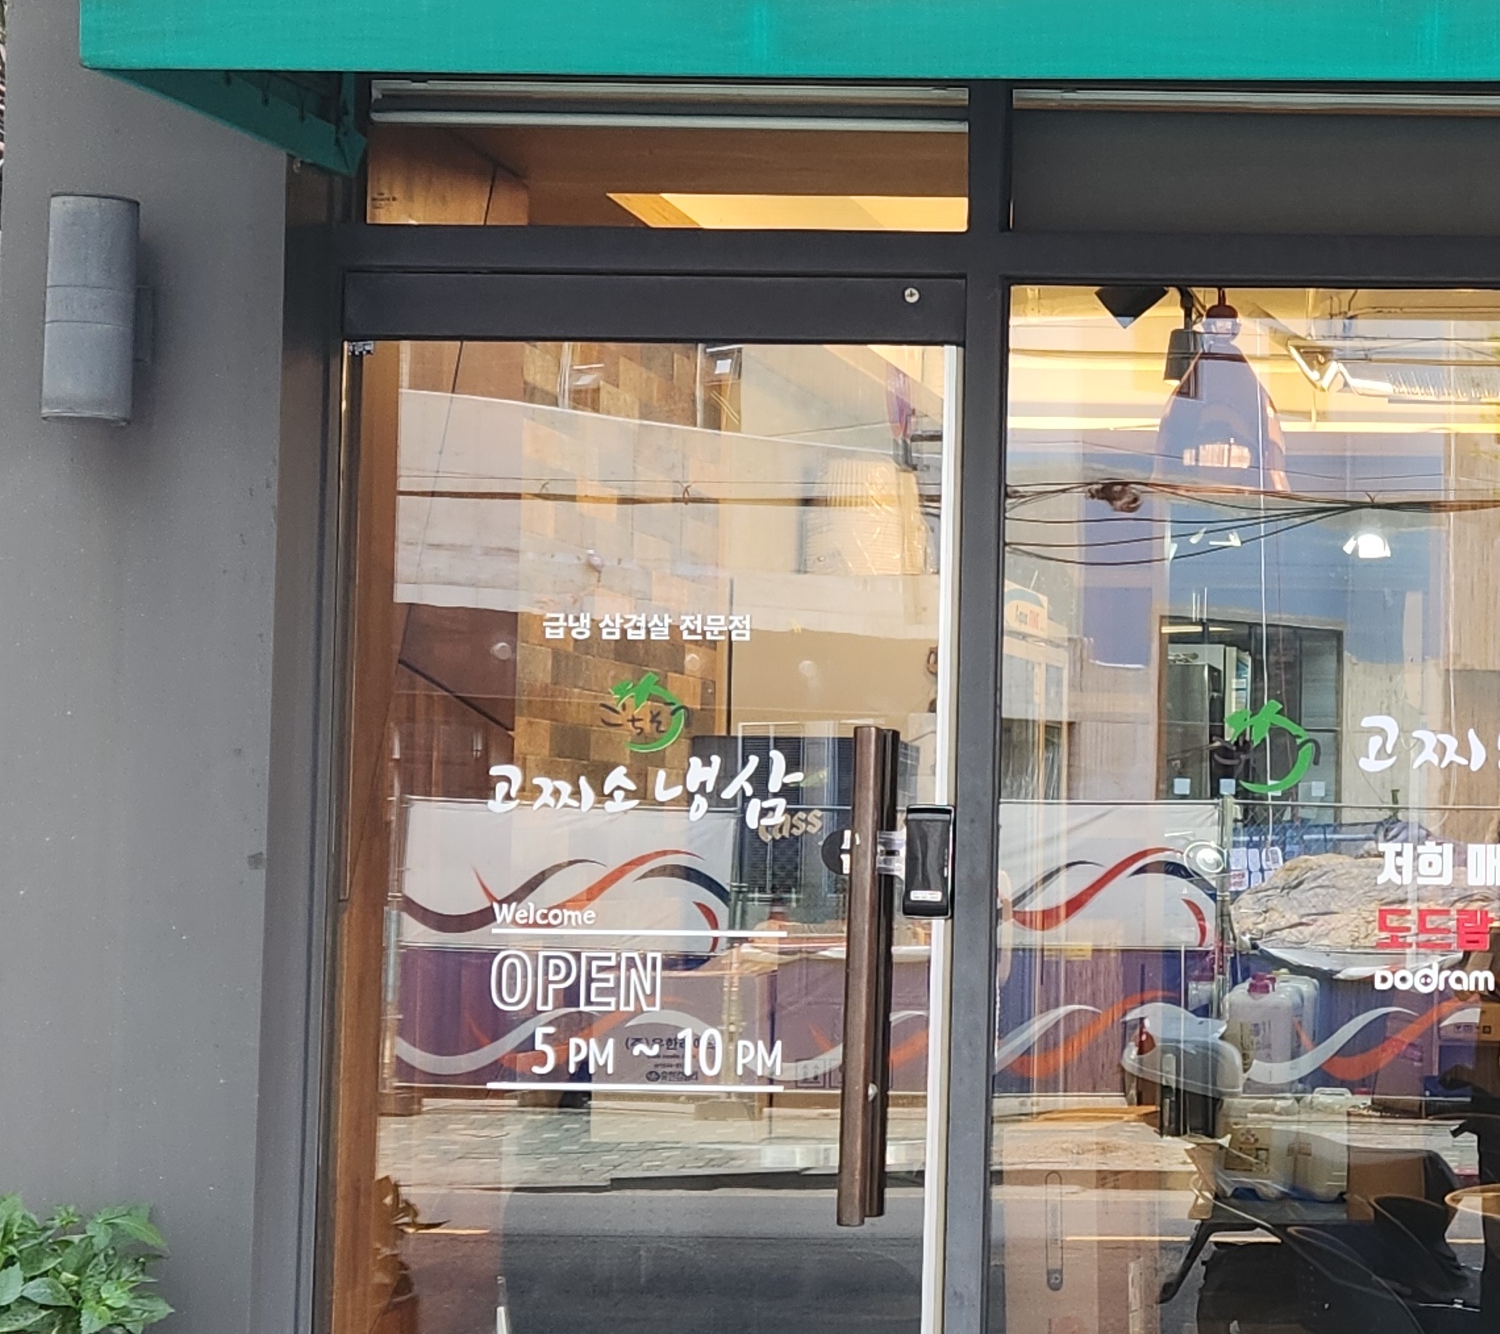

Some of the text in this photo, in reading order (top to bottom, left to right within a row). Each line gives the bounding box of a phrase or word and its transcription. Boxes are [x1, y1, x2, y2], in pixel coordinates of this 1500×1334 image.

[542, 612, 752, 642] 급냉 삼겹살 전문점
[1376, 843, 1456, 887] 저희
[492, 902, 597, 927] Welcome
[1375, 907, 1491, 952] 도드람
[490, 950, 663, 1013] OPEN
[532, 1027, 557, 1075] 5
[568, 1037, 615, 1075] PM
[677, 1027, 723, 1077] 10
[737, 1039, 783, 1077] PM
